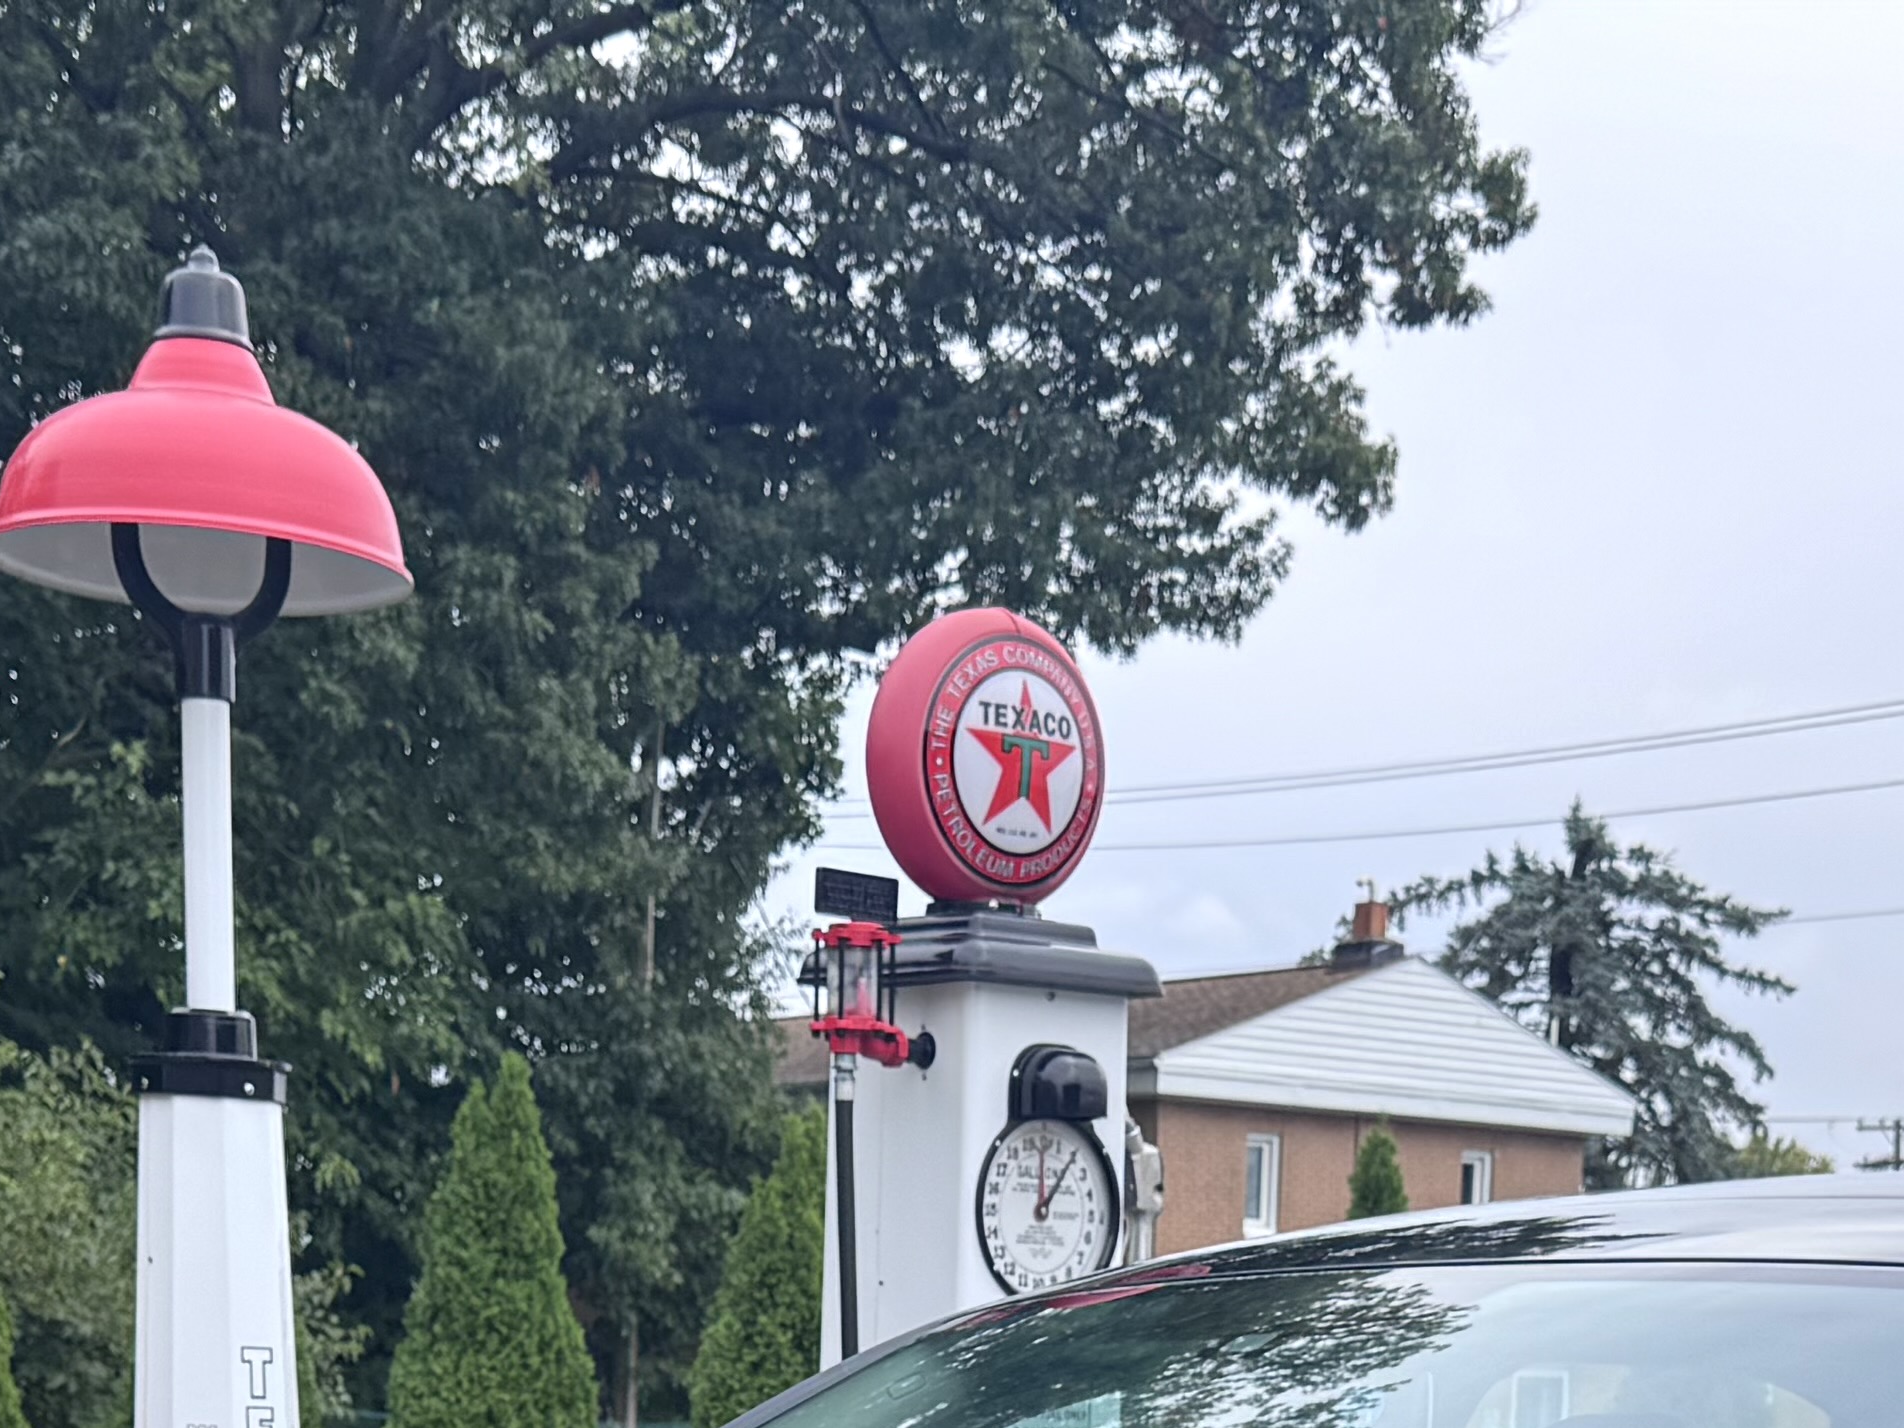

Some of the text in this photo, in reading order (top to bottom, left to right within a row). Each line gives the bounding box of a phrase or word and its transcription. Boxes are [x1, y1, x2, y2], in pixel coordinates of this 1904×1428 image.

[931, 707, 955, 750] THE
[948, 651, 1000, 698] TEXAS
[1002, 646, 1080, 705] COMPANY
[979, 701, 1072, 740] TEXACO
[934, 774, 1014, 878] PETROLEUM
